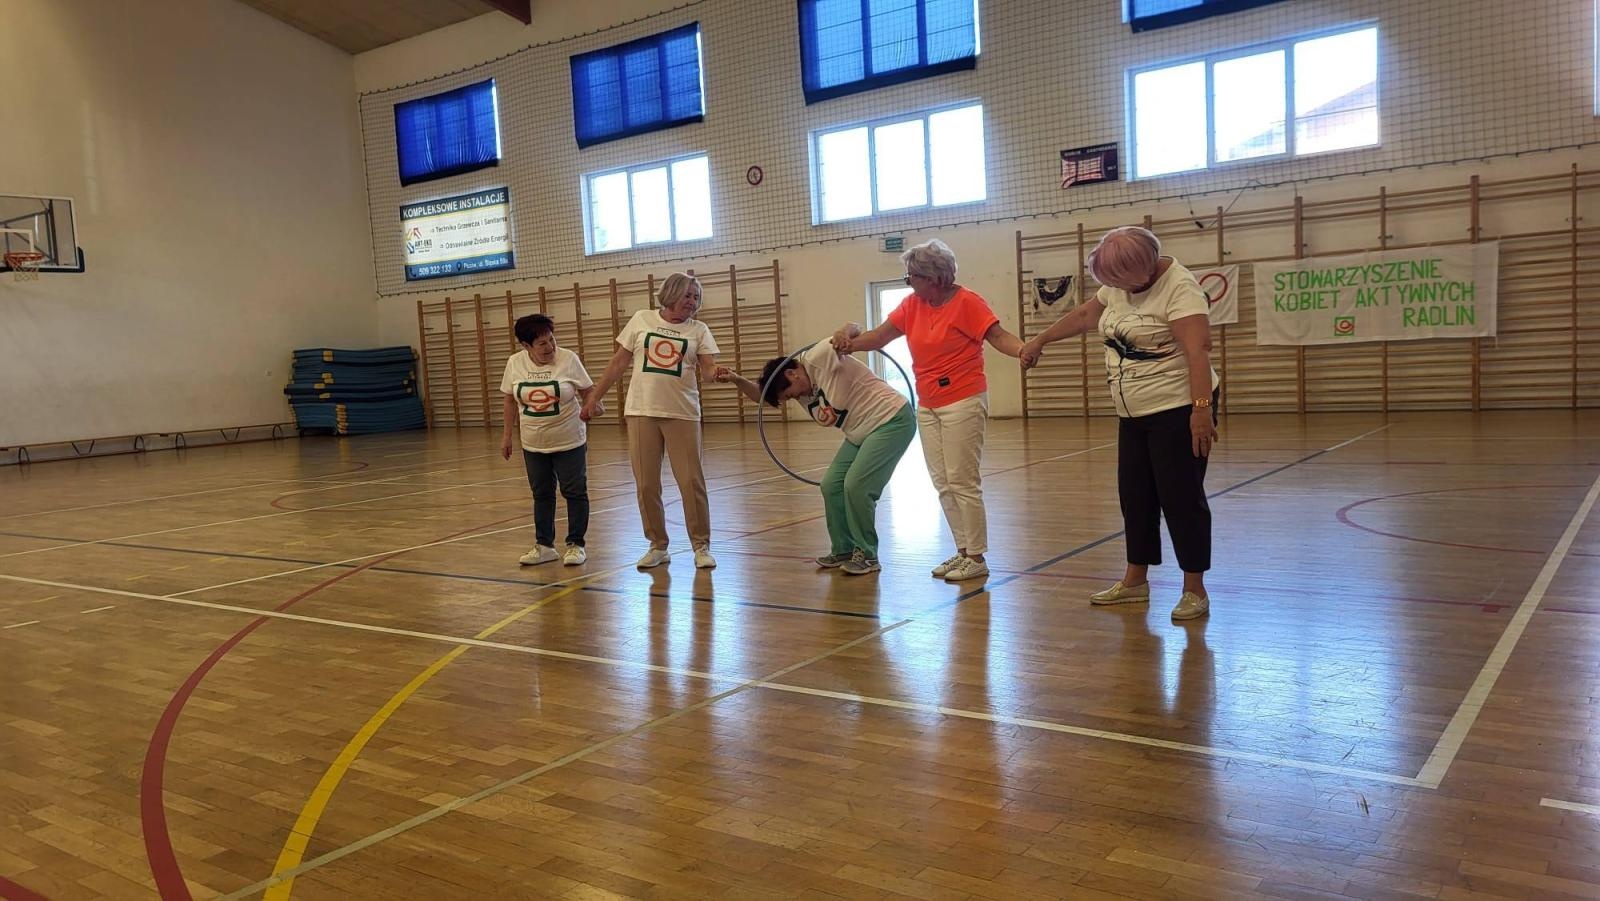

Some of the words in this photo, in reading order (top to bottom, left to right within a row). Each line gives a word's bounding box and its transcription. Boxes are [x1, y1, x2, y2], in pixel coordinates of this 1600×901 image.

[403, 201, 458, 218] KOMPLEKSOWE
[459, 192, 505, 208] INSTALACJE
[435, 225, 456, 233] Technika
[457, 221, 480, 230] Grzewcza
[484, 216, 508, 225] Sanitarna
[445, 240, 473, 249] Odnawialne
[418, 266, 429, 276] 509
[430, 265, 441, 275] 322
[441, 263, 452, 273] 133
[1273, 258, 1442, 292] STOWARZYSZENIE
[1274, 289, 1341, 312] KOBIET
[1355, 281, 1475, 308] AKTYWNYCH
[1403, 305, 1475, 327] RADLIN
